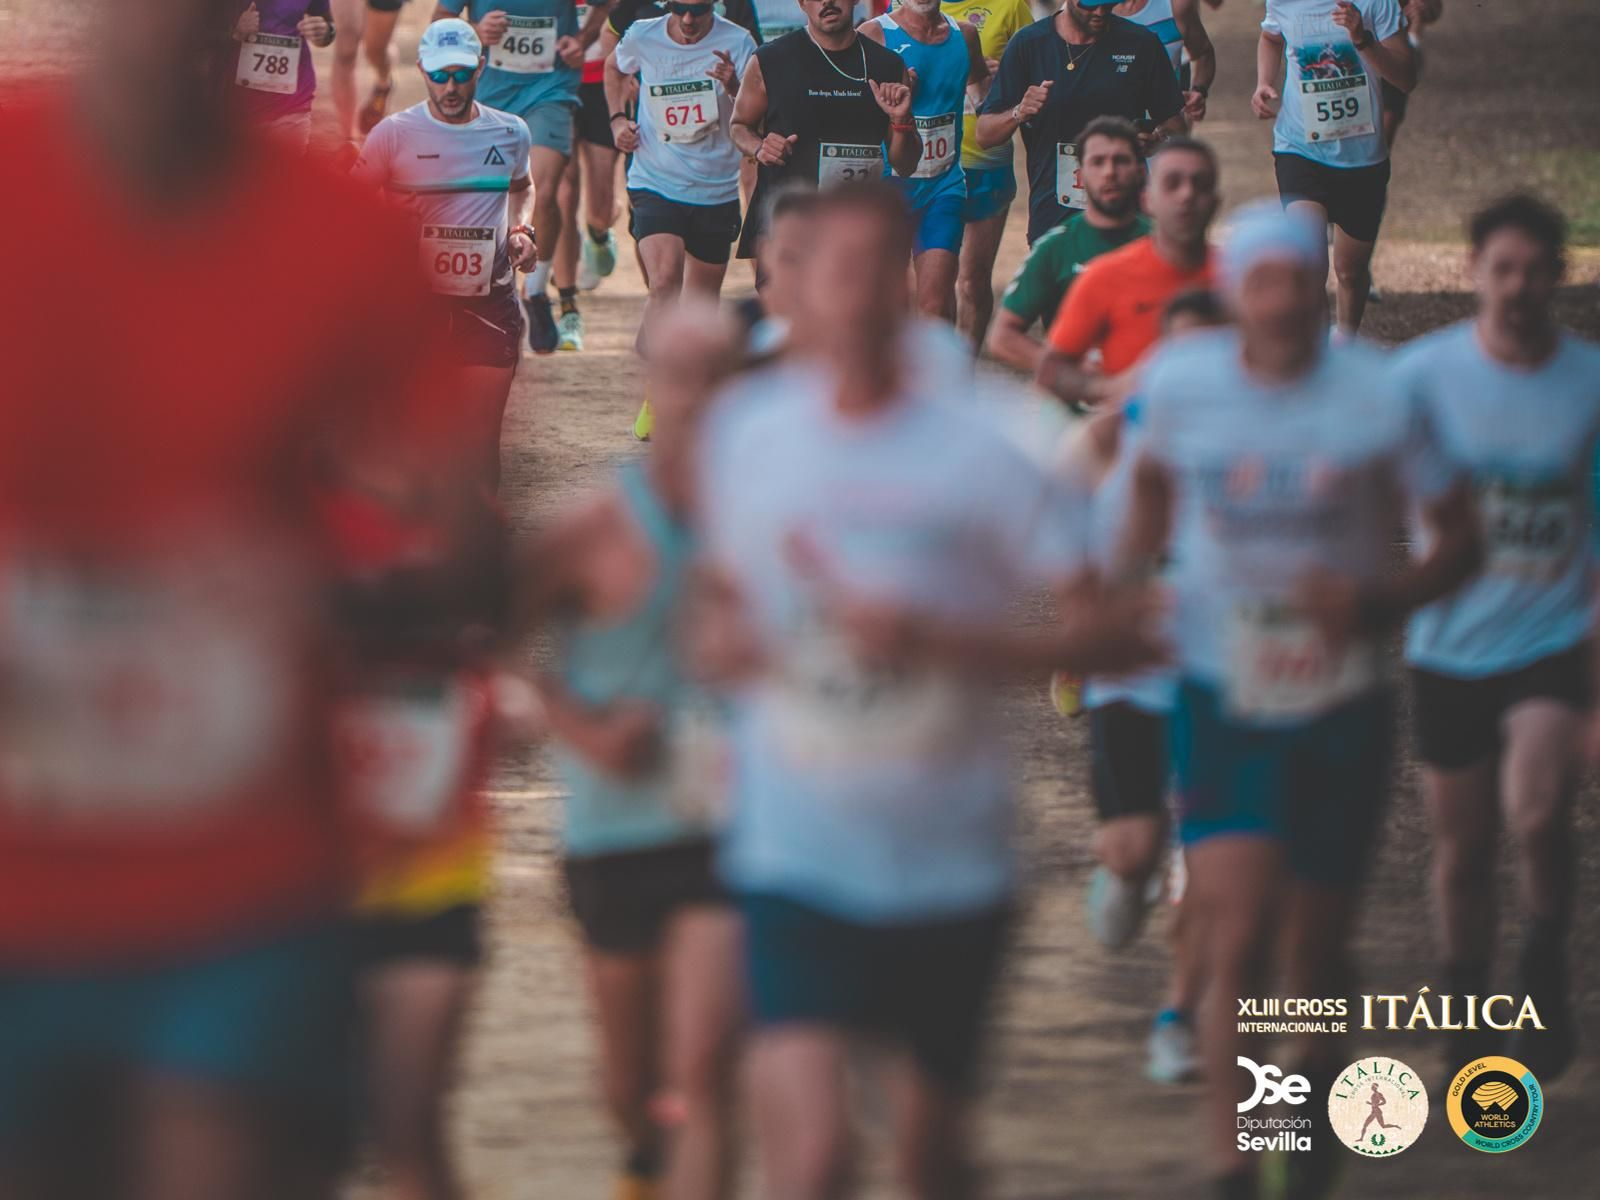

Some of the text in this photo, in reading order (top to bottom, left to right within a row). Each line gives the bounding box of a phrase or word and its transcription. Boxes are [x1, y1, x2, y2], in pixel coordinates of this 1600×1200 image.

[503, 36, 544, 56] 466
[253, 53, 289, 75] 788
[665, 104, 707, 126] 671
[1316, 97, 1359, 122] 559
[434, 251, 482, 276] 603
